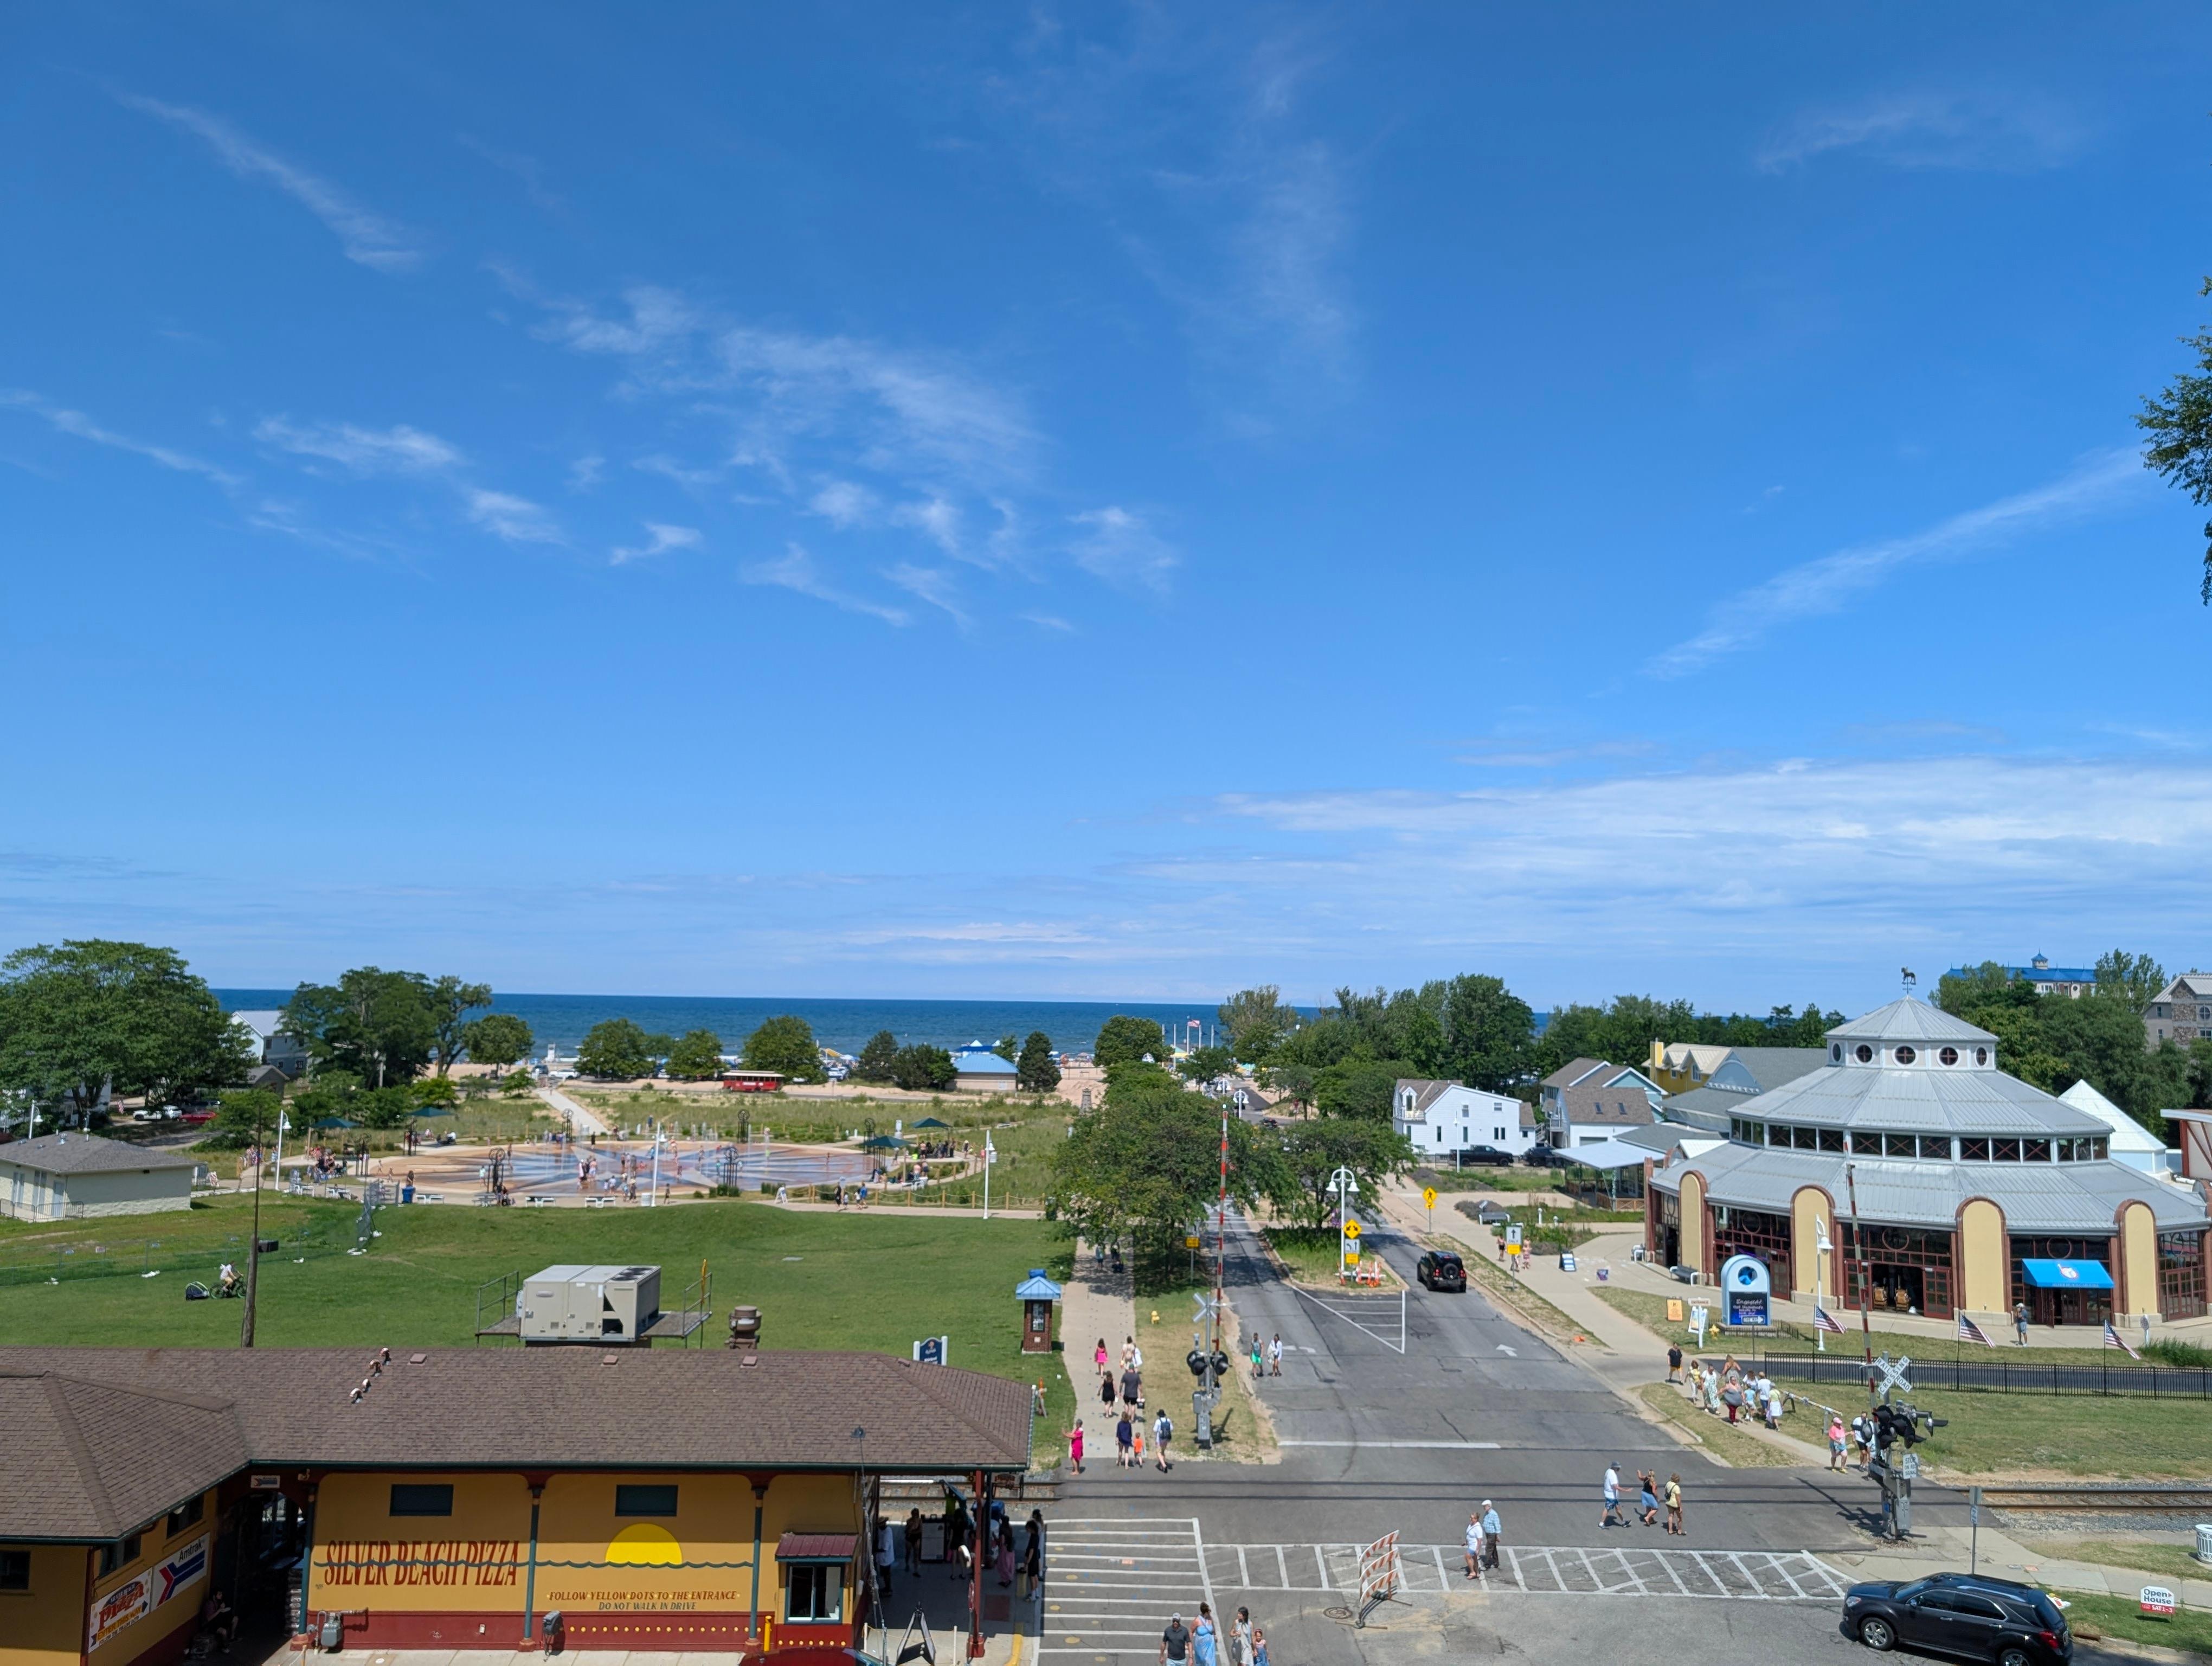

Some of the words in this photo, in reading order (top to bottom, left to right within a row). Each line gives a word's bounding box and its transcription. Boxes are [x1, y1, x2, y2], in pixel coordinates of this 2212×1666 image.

[1876, 1359, 1891, 1374] RAIL
[1895, 1375, 1909, 1390] ROAD
[1880, 1357, 1908, 1392] CROSSING
[178, 1539, 202, 1562] Amtrak
[325, 1540, 390, 1585] SILVER
[394, 1540, 461, 1585] BEACH
[462, 1540, 519, 1585] PIZZA
[550, 1591, 586, 1600] FOLLOW
[590, 1591, 627, 1600] YELLOW
[630, 1591, 654, 1600] DOTS
[657, 1591, 669, 1600] TO
[672, 1591, 689, 1600] THE
[691, 1591, 737, 1600] ENTRANCE
[2143, 1588, 2168, 1597] Open
[2144, 1595, 2171, 1604] House
